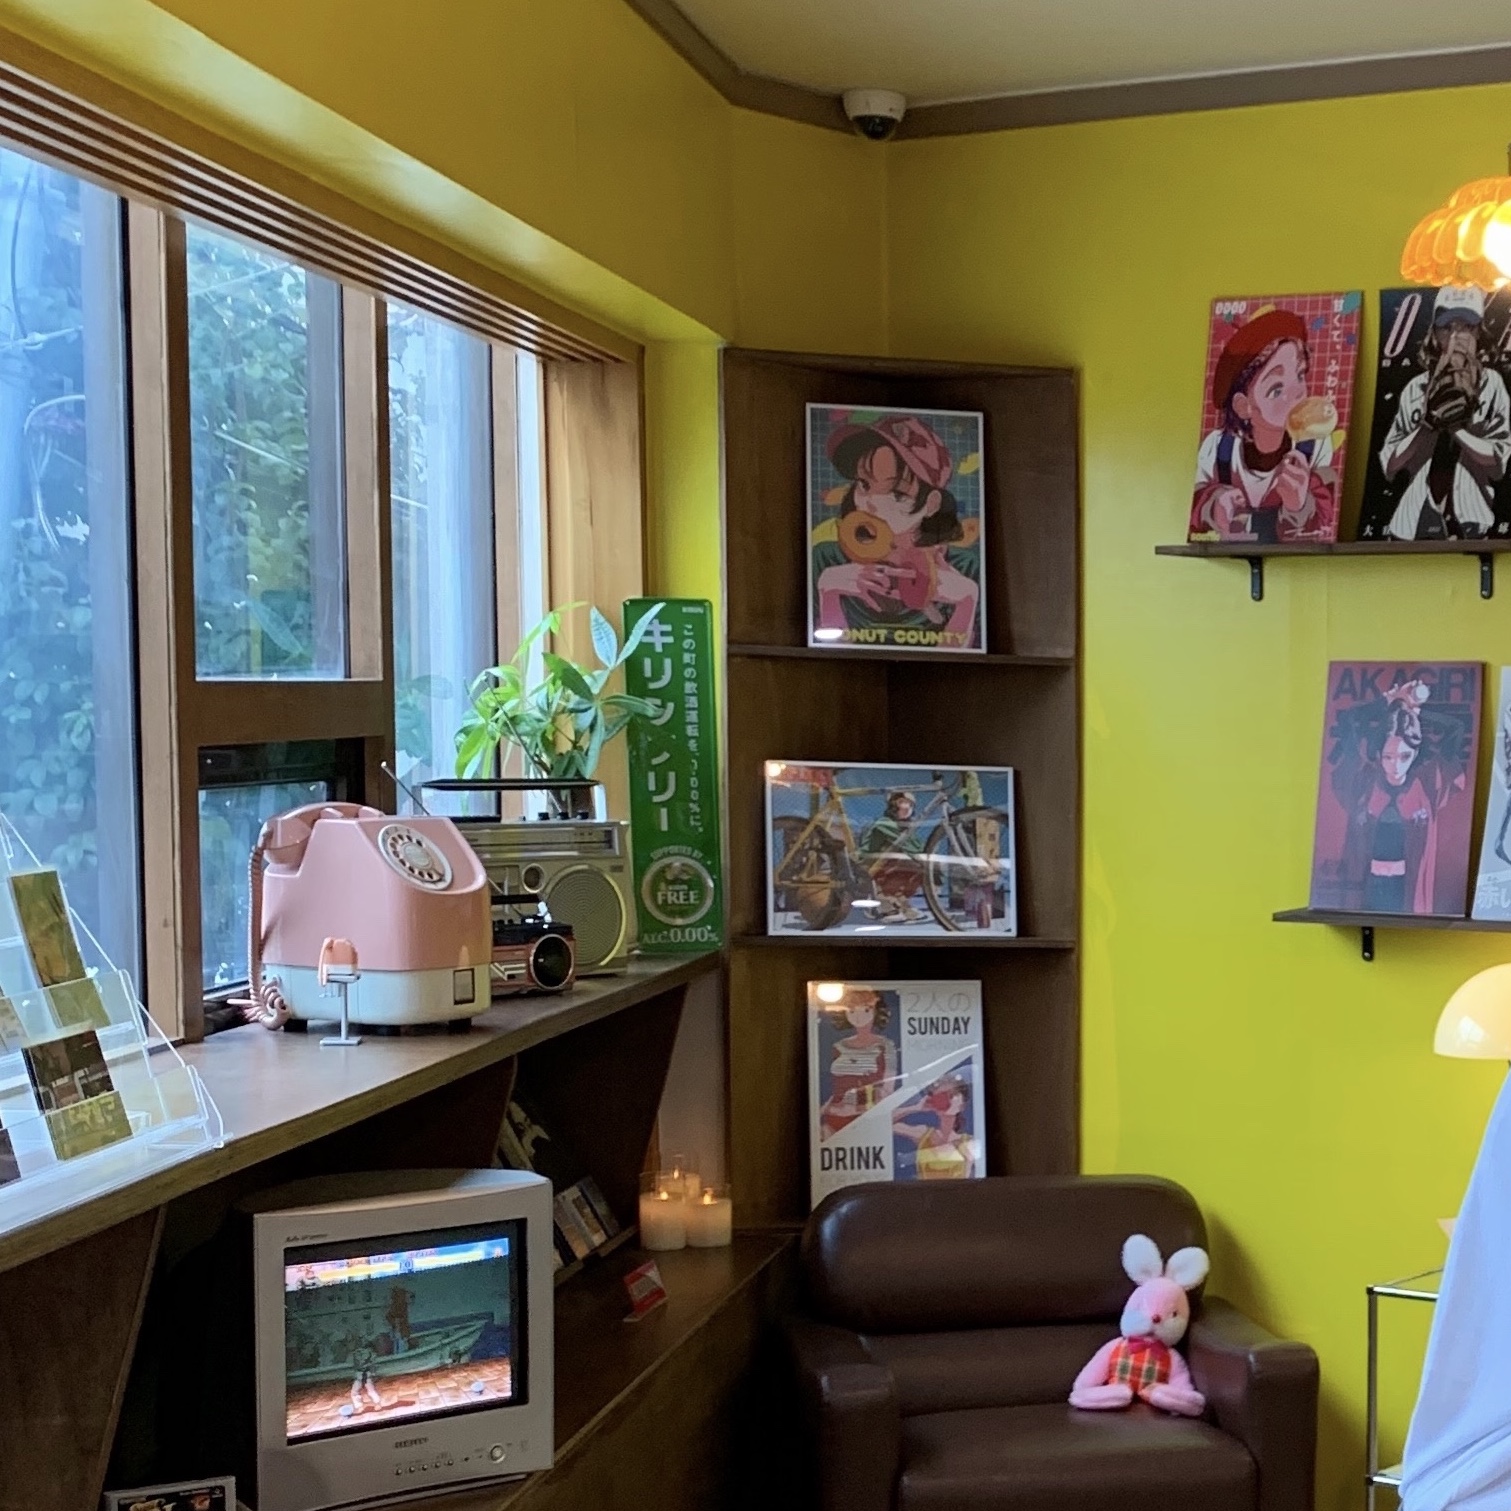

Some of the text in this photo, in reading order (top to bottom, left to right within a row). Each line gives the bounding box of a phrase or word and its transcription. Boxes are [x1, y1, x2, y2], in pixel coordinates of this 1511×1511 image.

[893, 630, 967, 645] COUNTY
[657, 890, 700, 905] FREE
[907, 1016, 970, 1036] SUNDAY
[820, 1146, 886, 1172] DRINK
